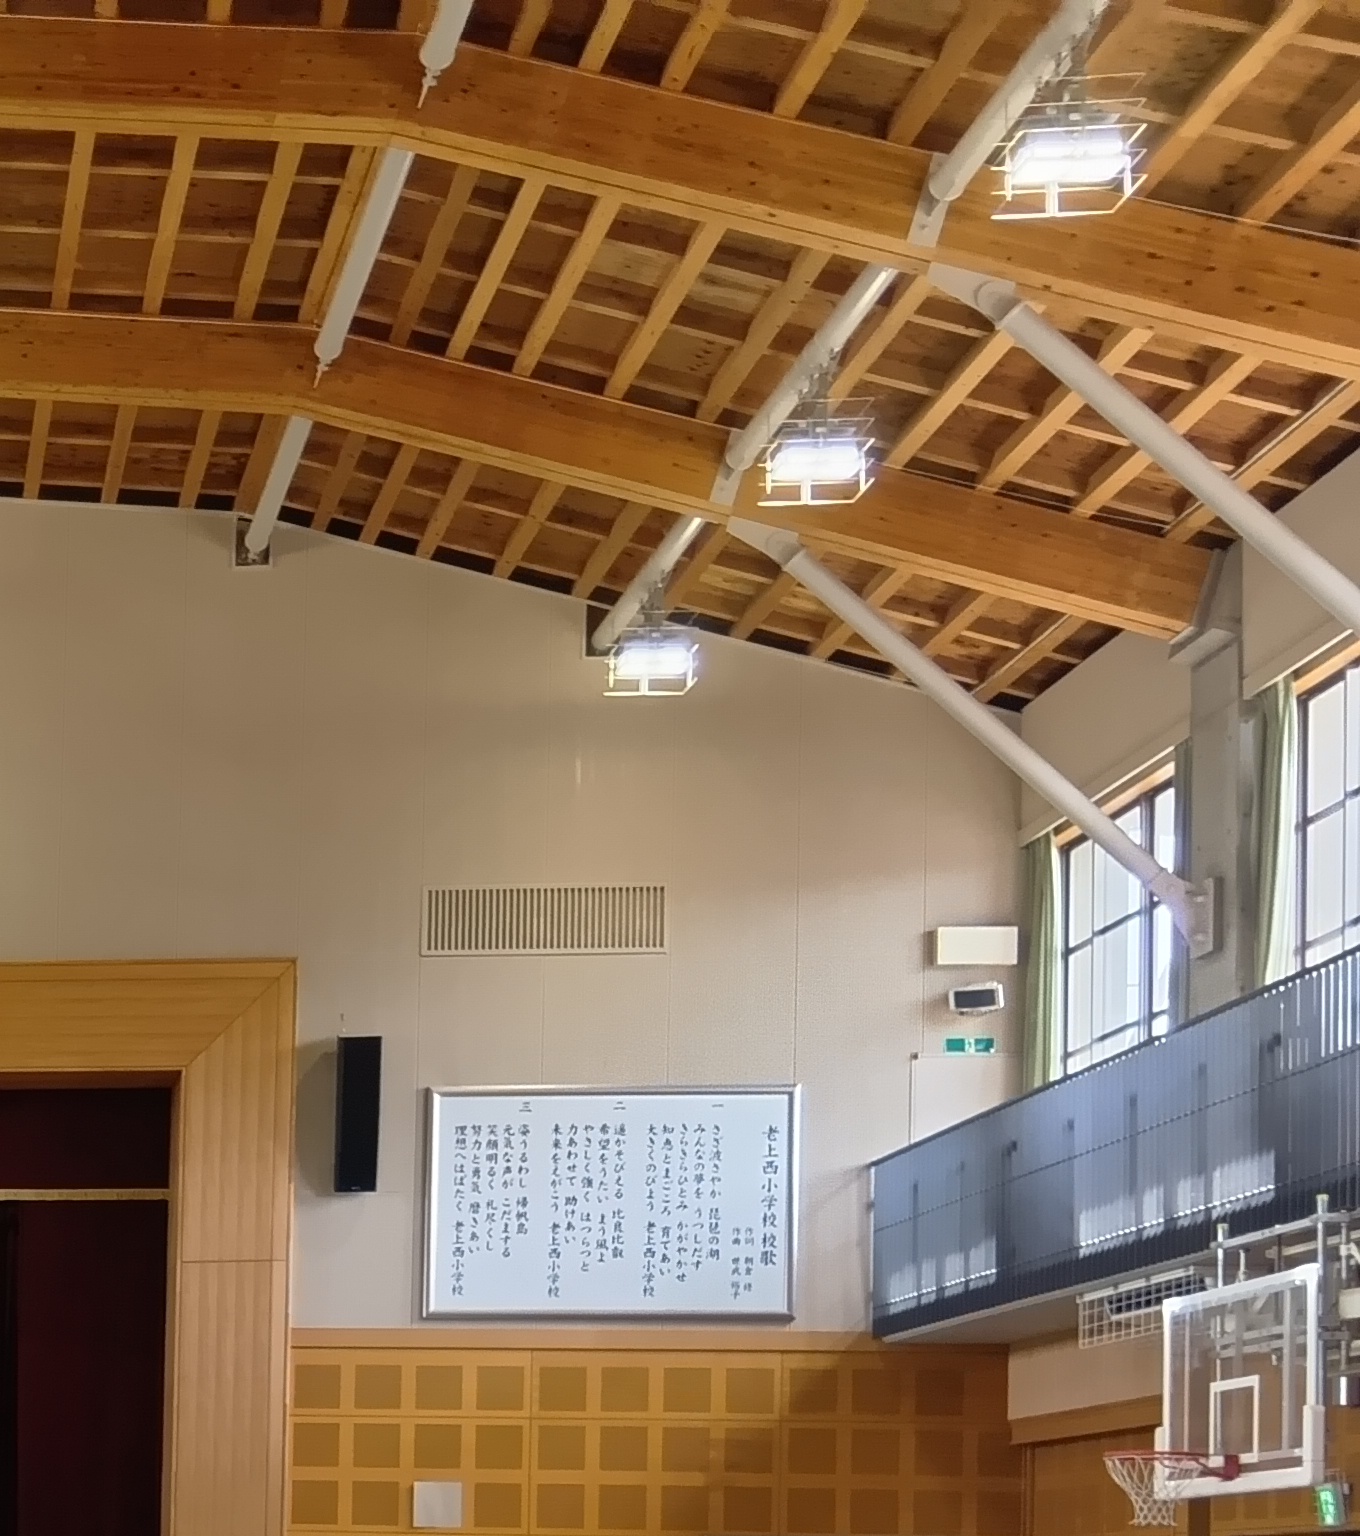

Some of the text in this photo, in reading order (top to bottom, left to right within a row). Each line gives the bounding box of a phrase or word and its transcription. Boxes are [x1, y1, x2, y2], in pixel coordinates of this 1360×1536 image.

[760, 1125, 779, 1266] 老上西小学校 校歌
[451, 1220, 465, 1295] 老上西小学校
[547, 1222, 561, 1298] 老上西小学校
[642, 1221, 656, 1297] 老上西小学校
